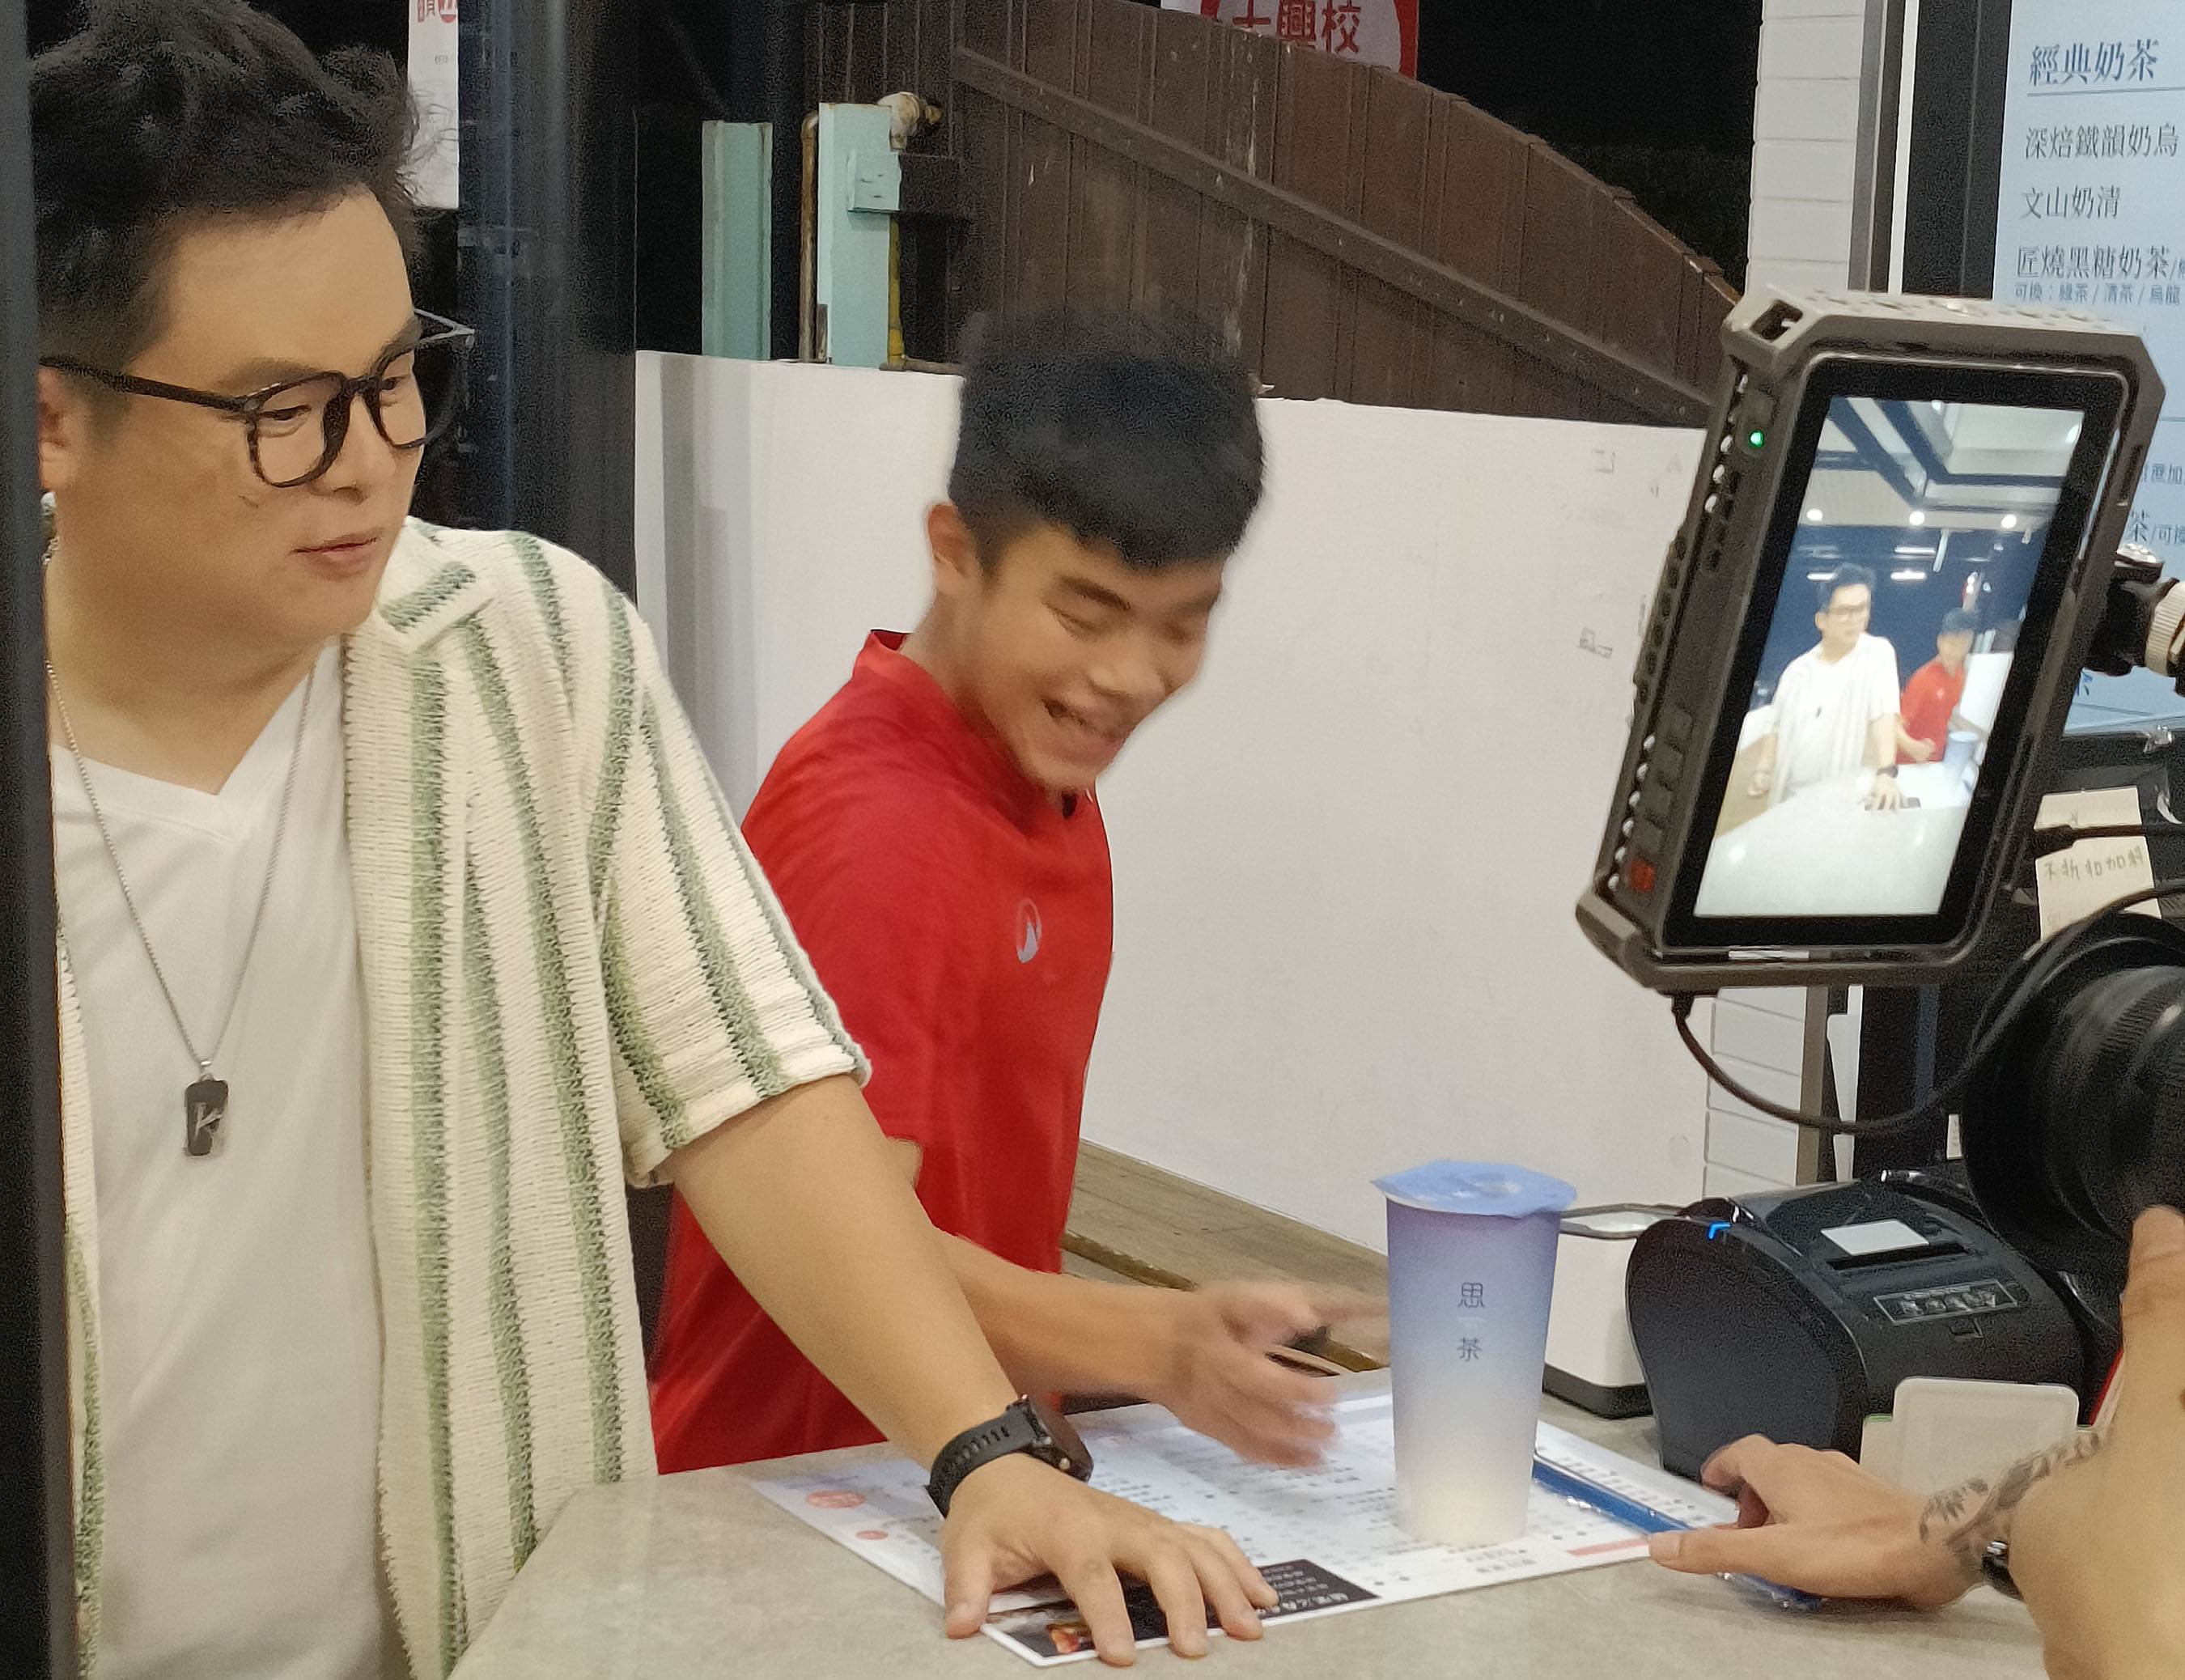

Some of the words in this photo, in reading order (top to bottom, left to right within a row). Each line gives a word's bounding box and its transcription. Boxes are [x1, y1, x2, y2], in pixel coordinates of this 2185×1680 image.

[2030, 39, 2159, 86] 經典奶茶
[2022, 185, 2120, 219] 文山奶清
